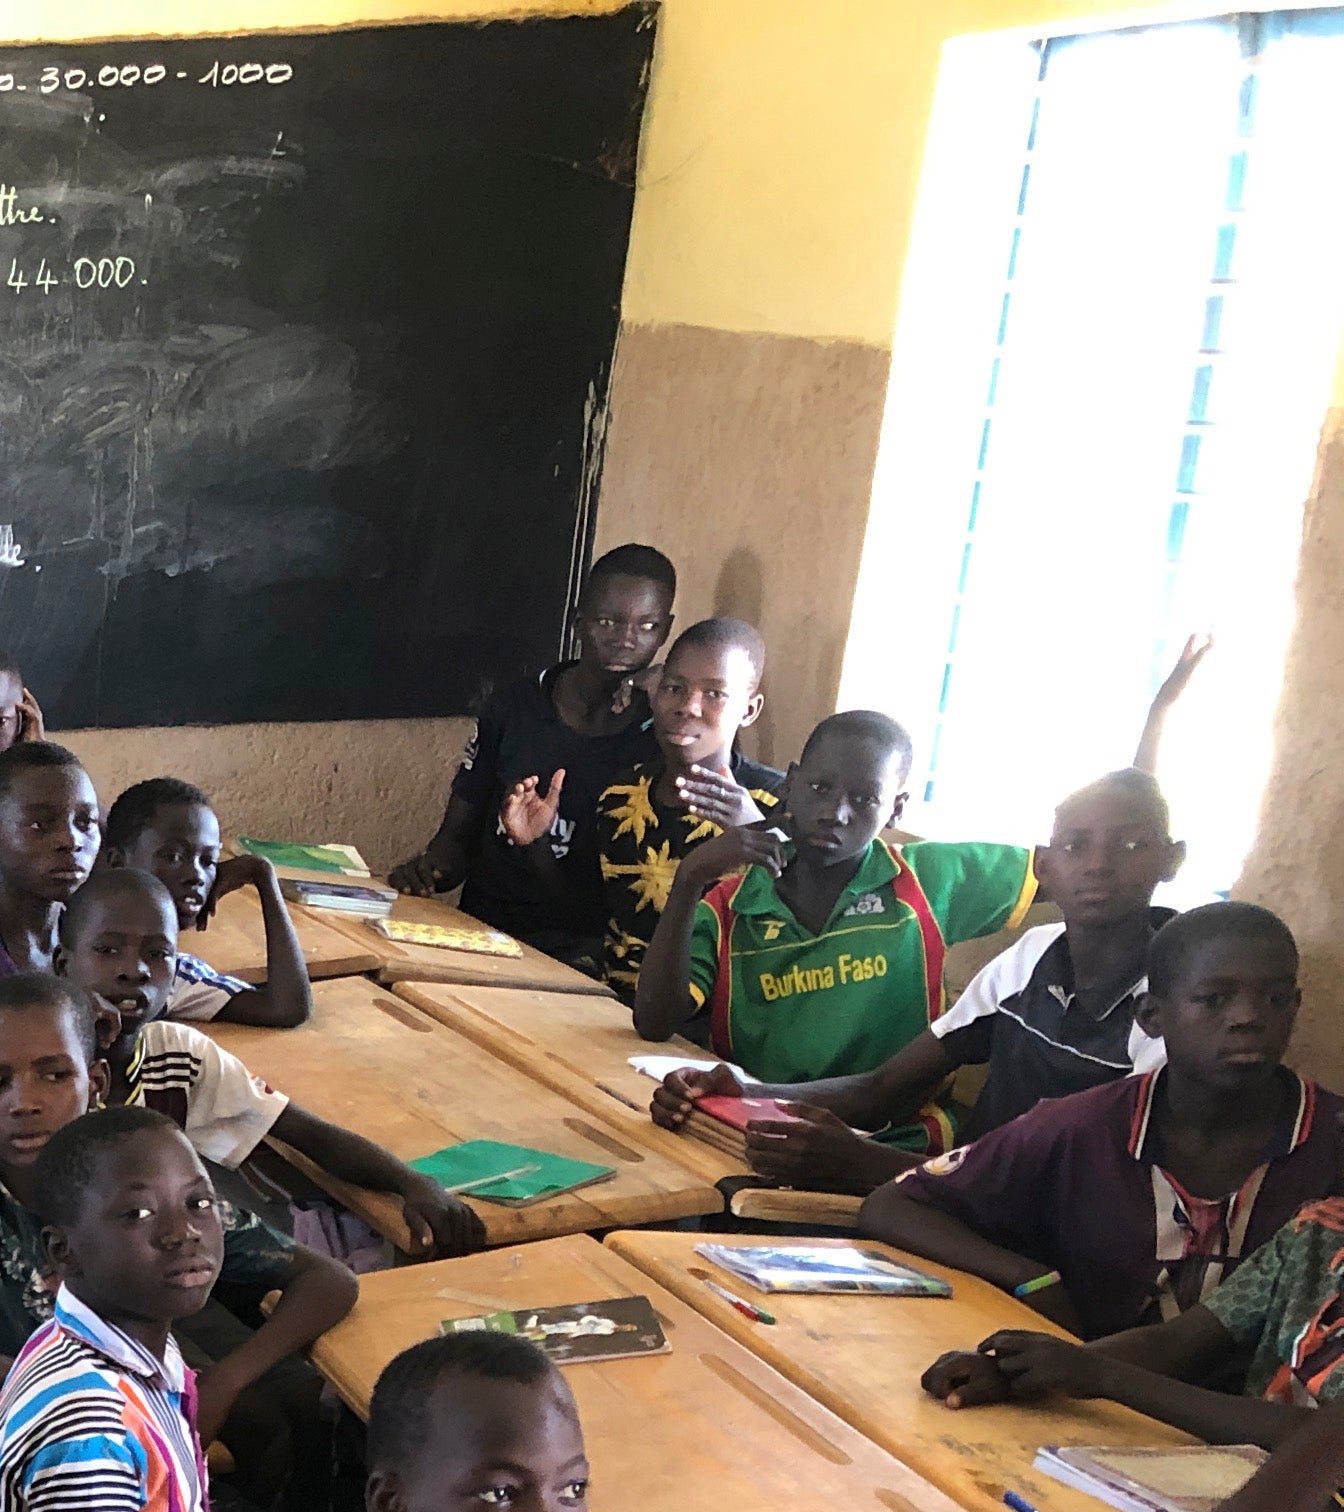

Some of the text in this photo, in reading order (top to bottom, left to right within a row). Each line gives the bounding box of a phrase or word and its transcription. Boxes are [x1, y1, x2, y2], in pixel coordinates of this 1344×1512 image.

[40, 64, 166, 92] 30.000
[199, 61, 293, 88] 1000
[760, 953, 888, 1001] Burkina Faso
